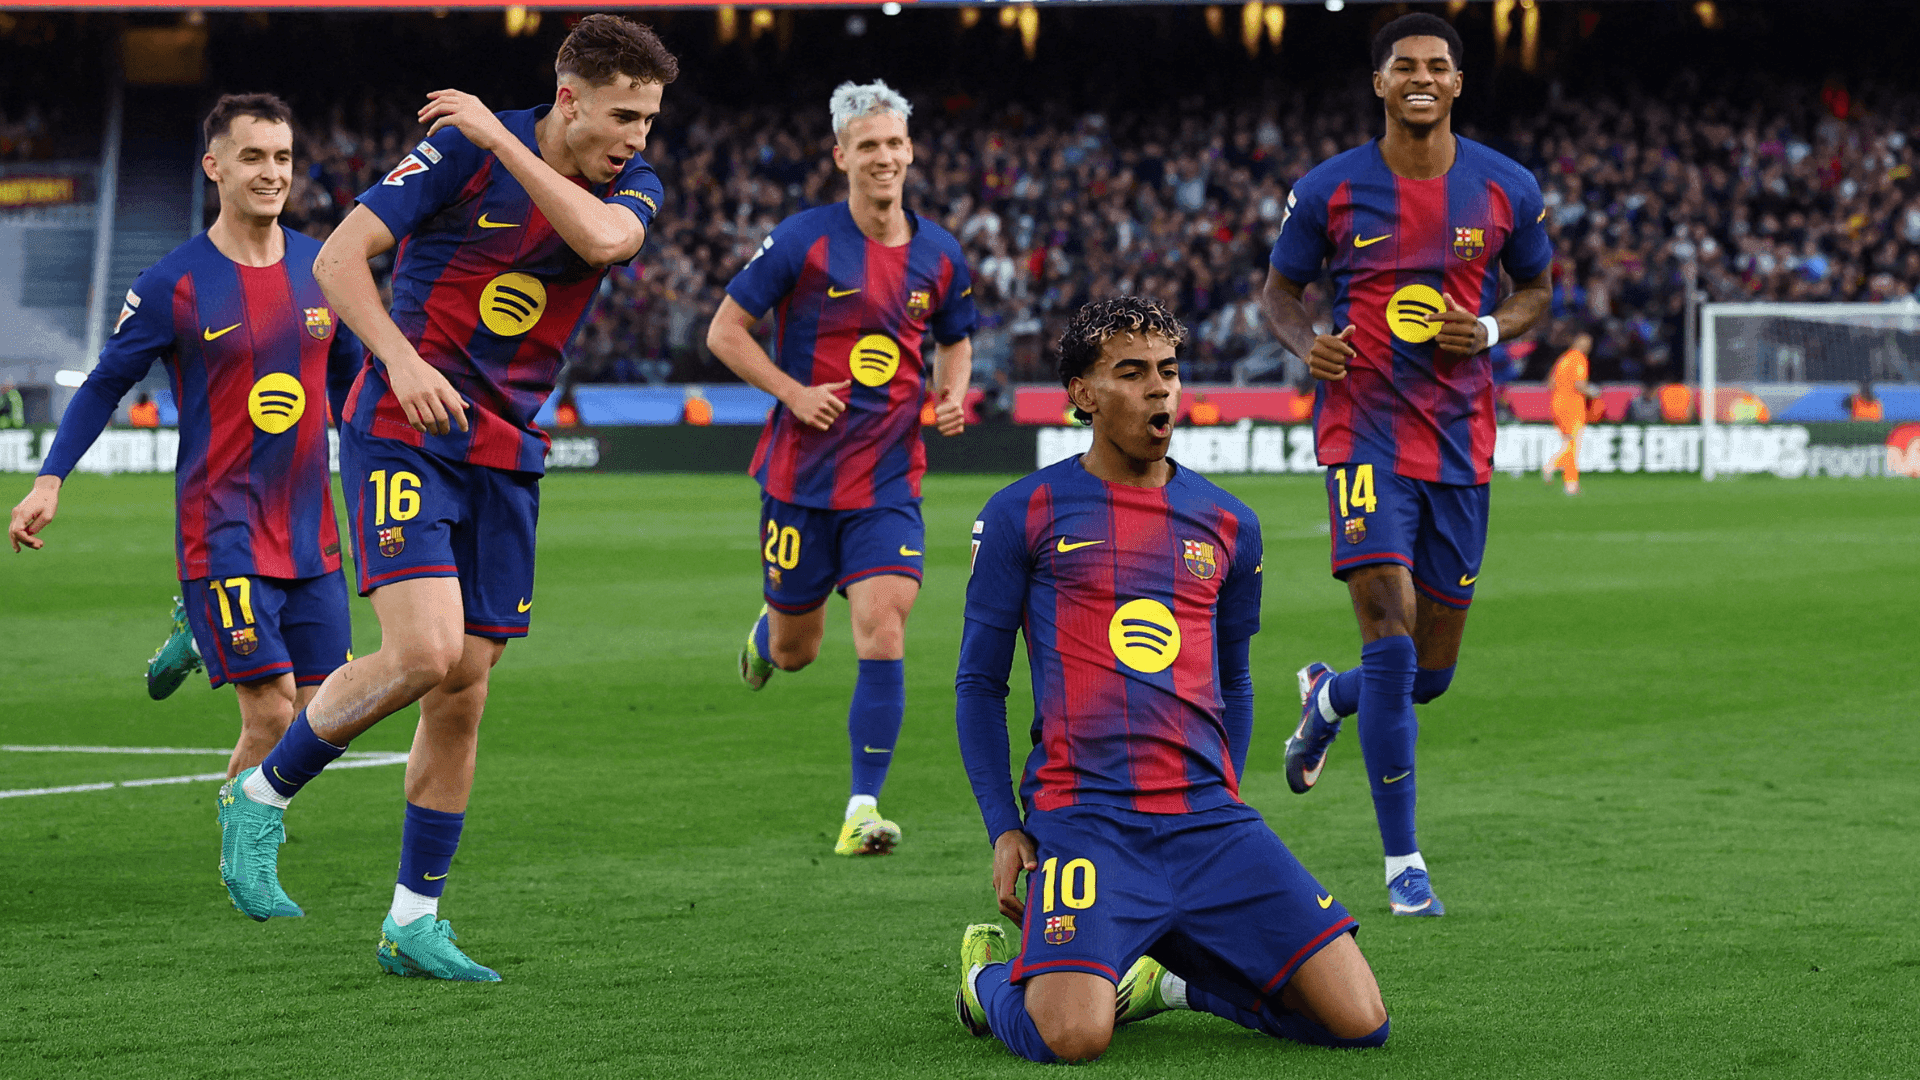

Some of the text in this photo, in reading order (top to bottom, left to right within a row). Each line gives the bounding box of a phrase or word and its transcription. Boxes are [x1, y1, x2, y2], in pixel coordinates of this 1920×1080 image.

[369, 469, 422, 526] 16
[1334, 464, 1377, 518] 14
[764, 518, 801, 570] 20
[208, 576, 255, 629] 17
[1041, 856, 1097, 914] 10
